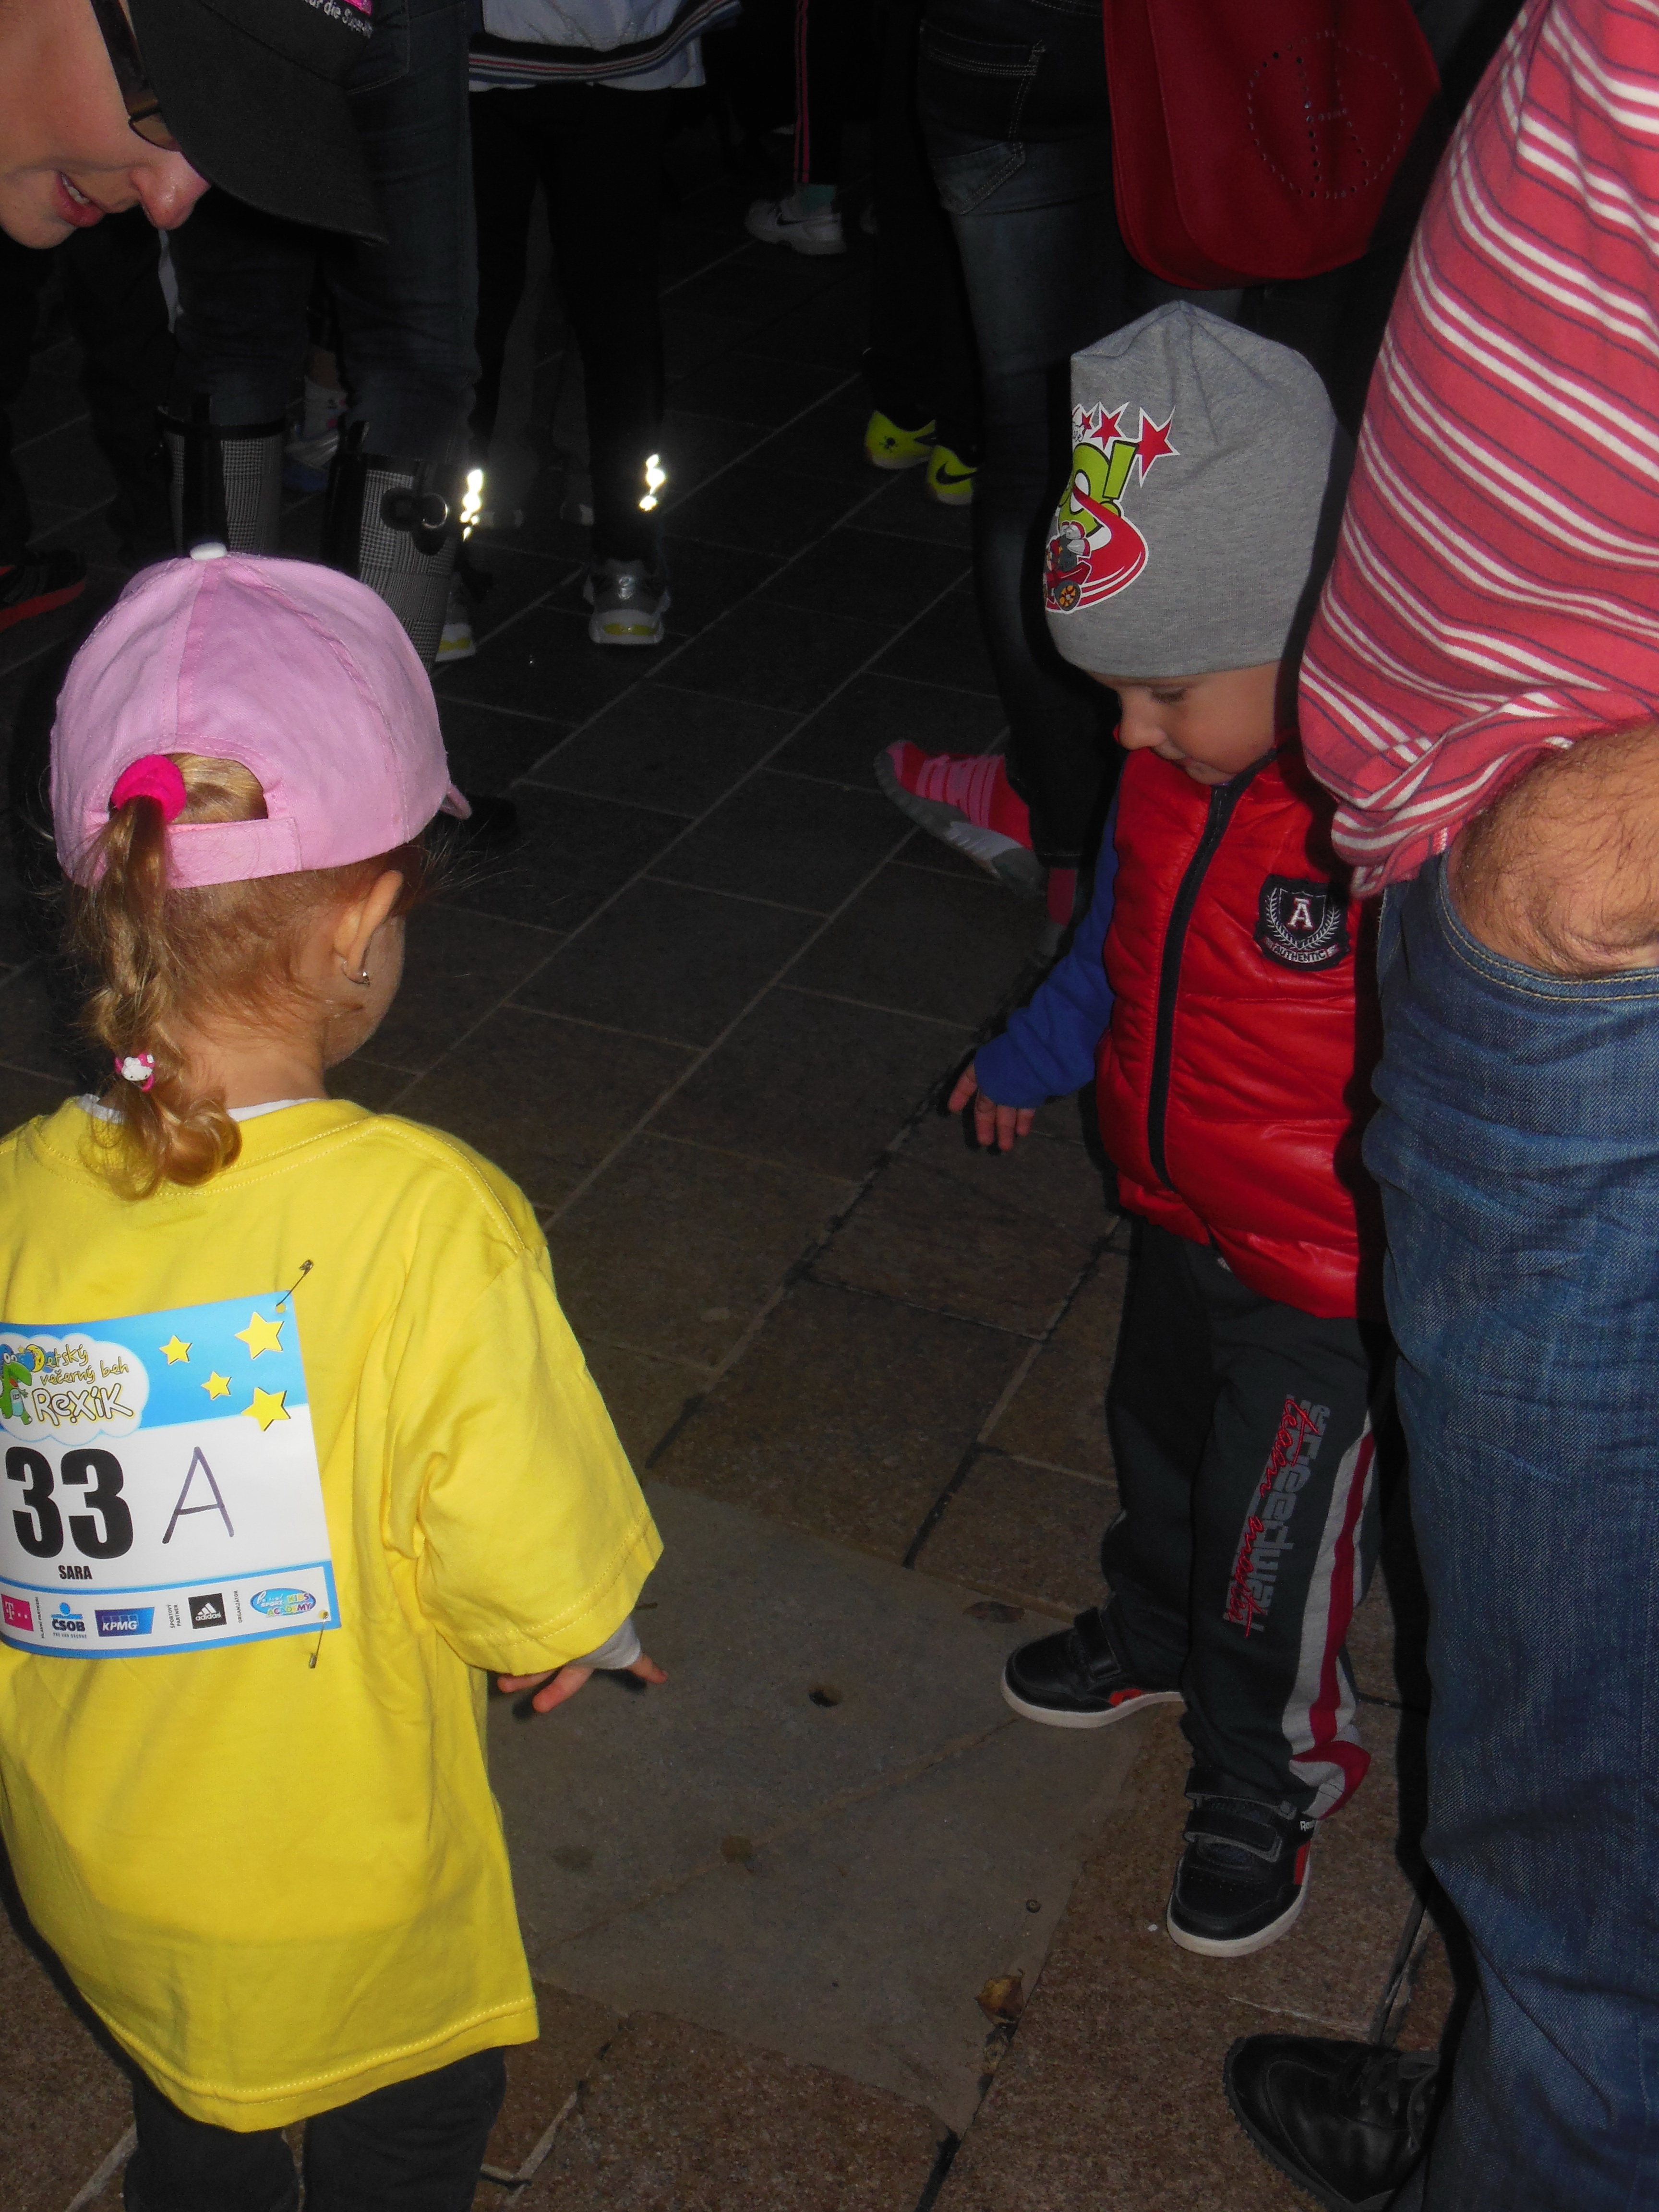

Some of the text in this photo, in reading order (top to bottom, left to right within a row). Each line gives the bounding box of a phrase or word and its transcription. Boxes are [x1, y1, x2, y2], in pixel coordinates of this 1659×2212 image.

[1286, 897, 1313, 930] A
[1273, 945, 1326, 962] AUTHENTIC
[40, 1356, 129, 1385] večerný beh
[5, 1446, 133, 1559] 33
[162, 1446, 234, 1544] A
[58, 1565, 93, 1580] SARA
[287, 1593, 310, 1604] KIDS
[195, 1612, 221, 1621] adidas
[267, 1603, 311, 1617] ACADEMY
[52, 1618, 85, 1632] ČSOB
[102, 1621, 137, 1631] KPMG
